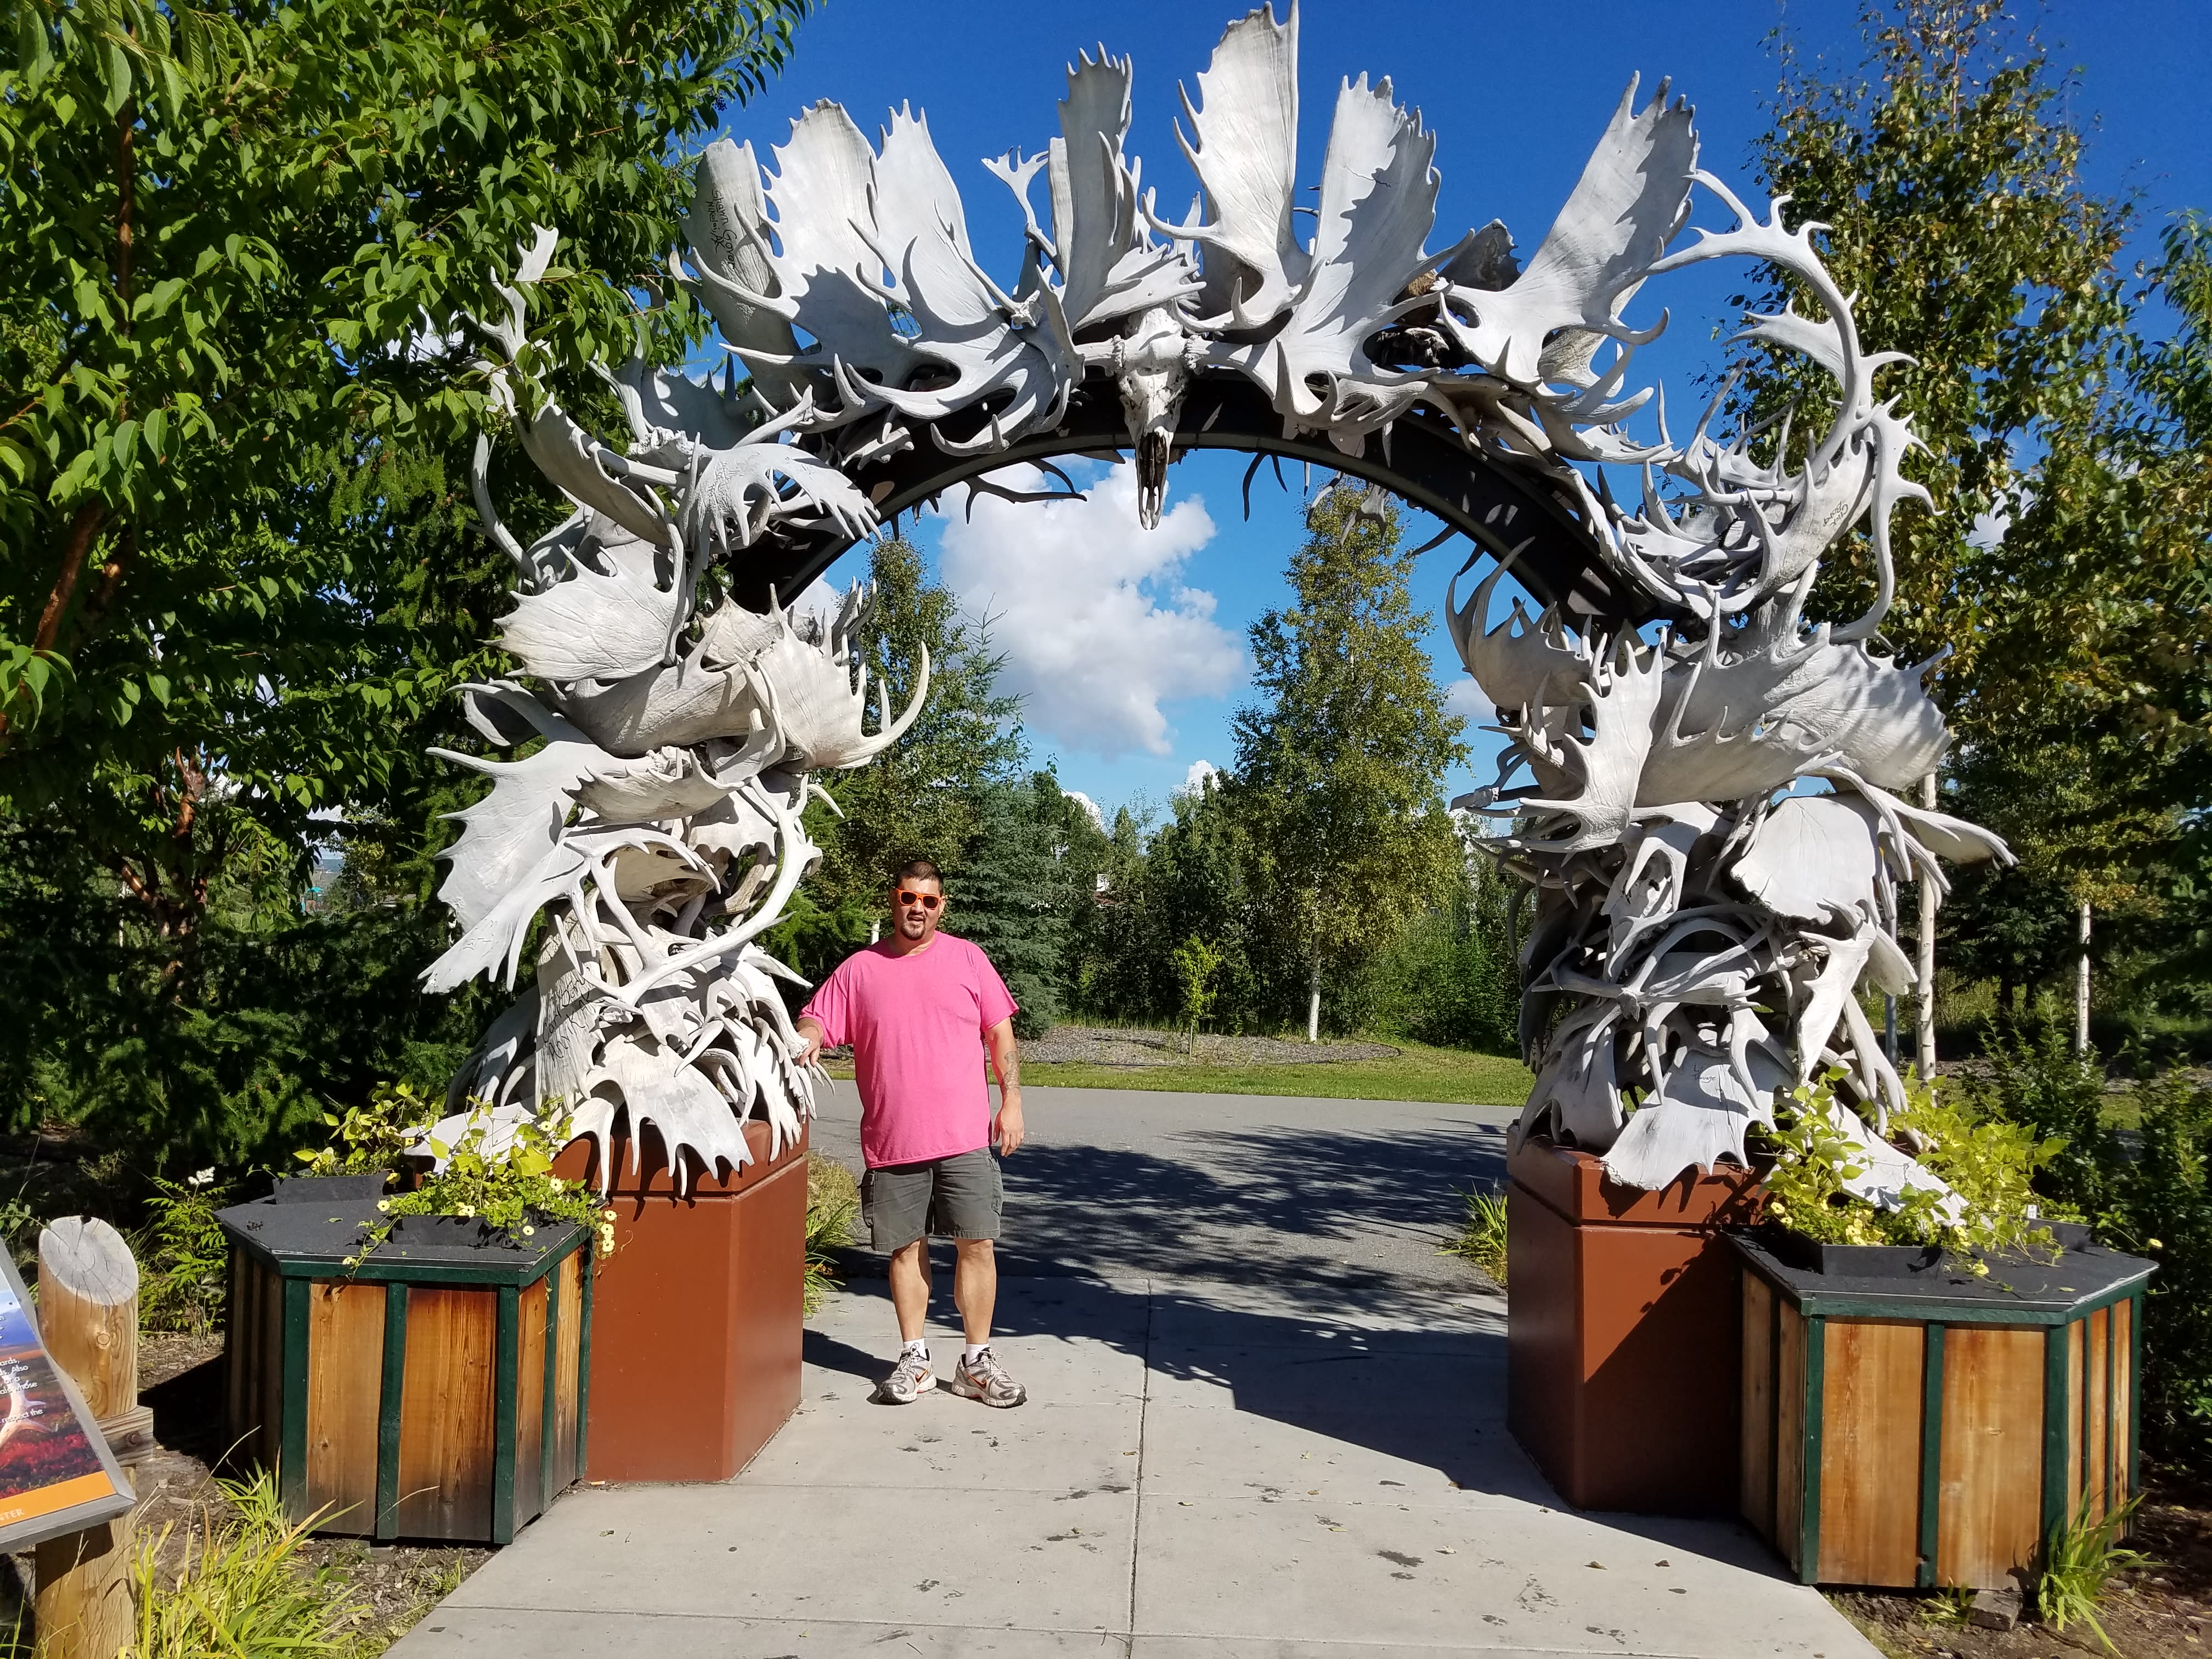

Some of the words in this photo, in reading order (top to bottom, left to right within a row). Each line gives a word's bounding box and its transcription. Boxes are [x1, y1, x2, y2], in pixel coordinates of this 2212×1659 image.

[712, 190, 729, 225] Shawn
[711, 234, 725, 254] AK
[579, 988, 605, 1020] AK
[543, 1006, 562, 1043] Carl
[14, 1382, 38, 1392] whose
[2, 1412, 29, 1424] respect
